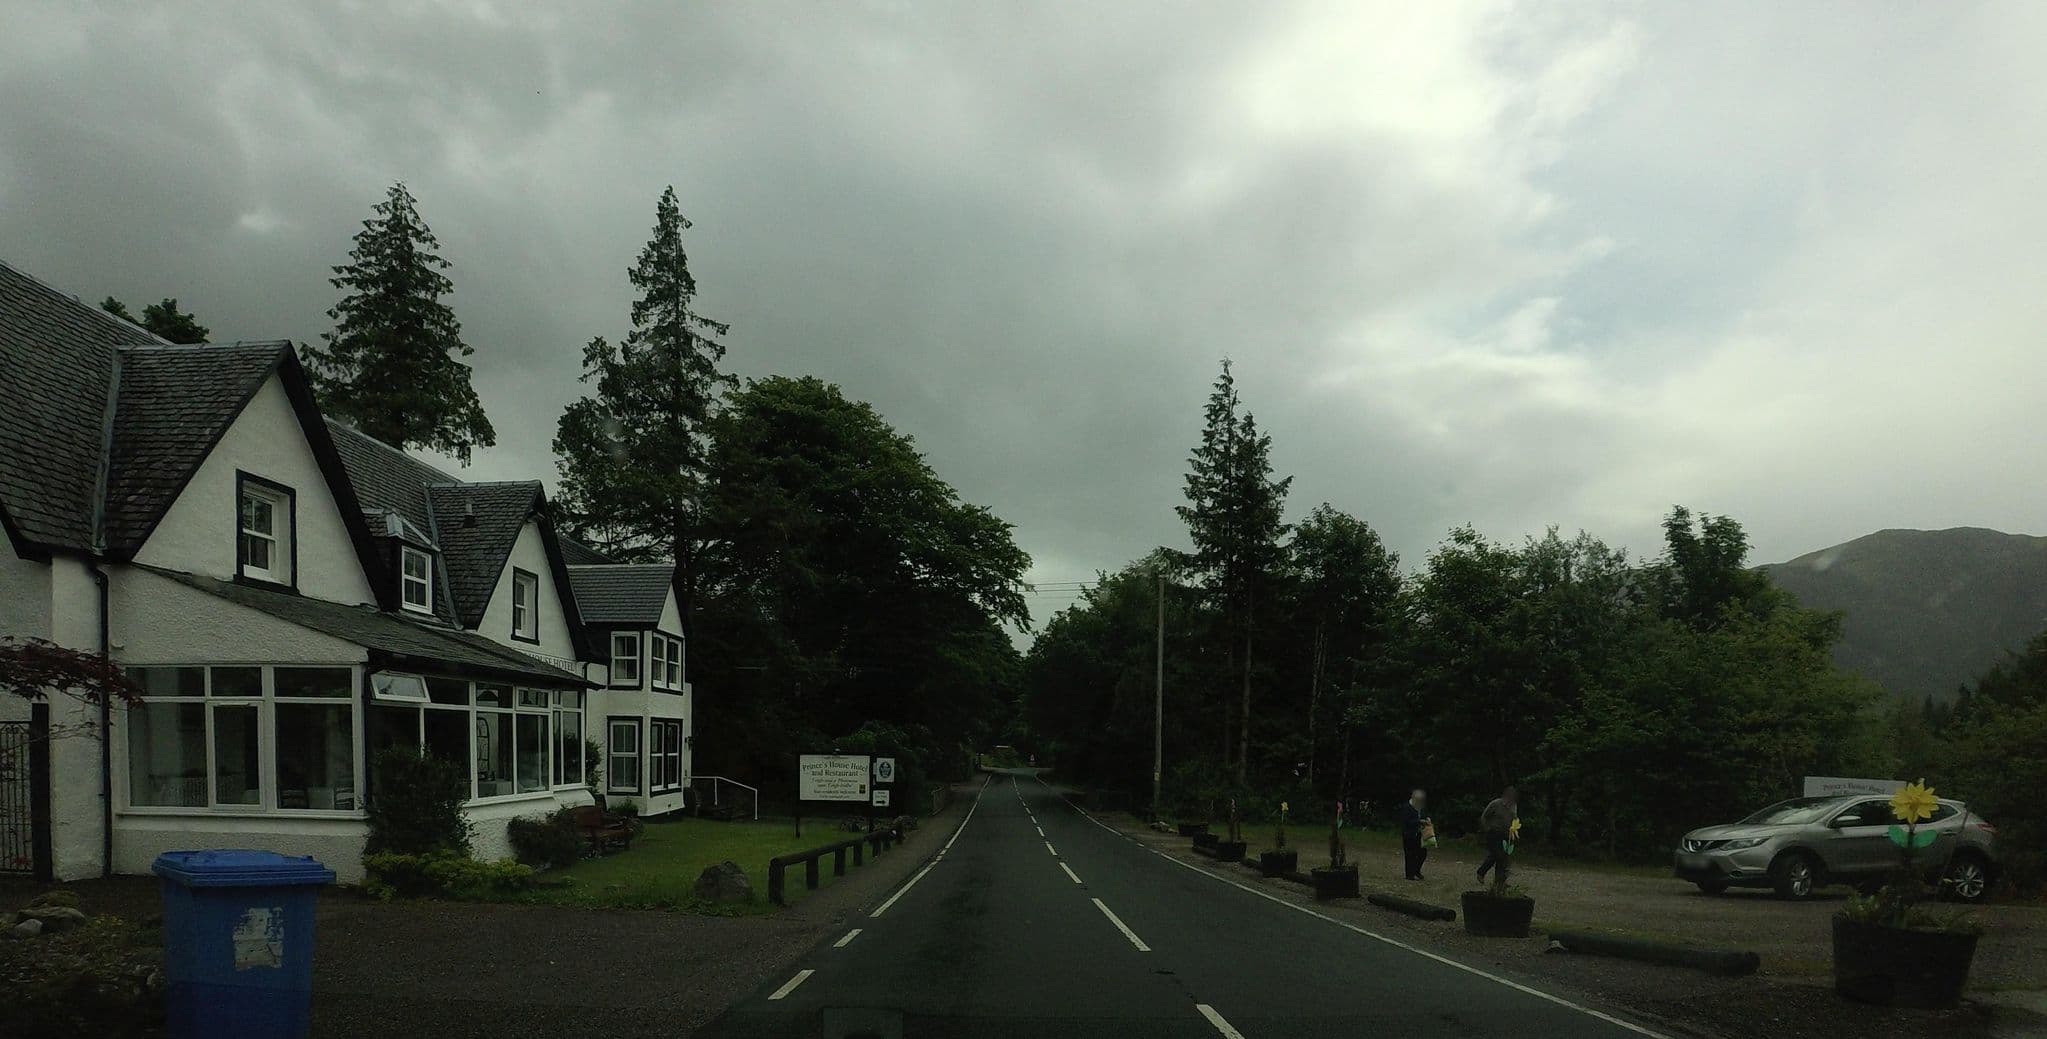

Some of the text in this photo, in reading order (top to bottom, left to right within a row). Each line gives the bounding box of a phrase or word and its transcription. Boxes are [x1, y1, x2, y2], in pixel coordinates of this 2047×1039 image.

[802, 761, 868, 772] Prince's House Hotel
